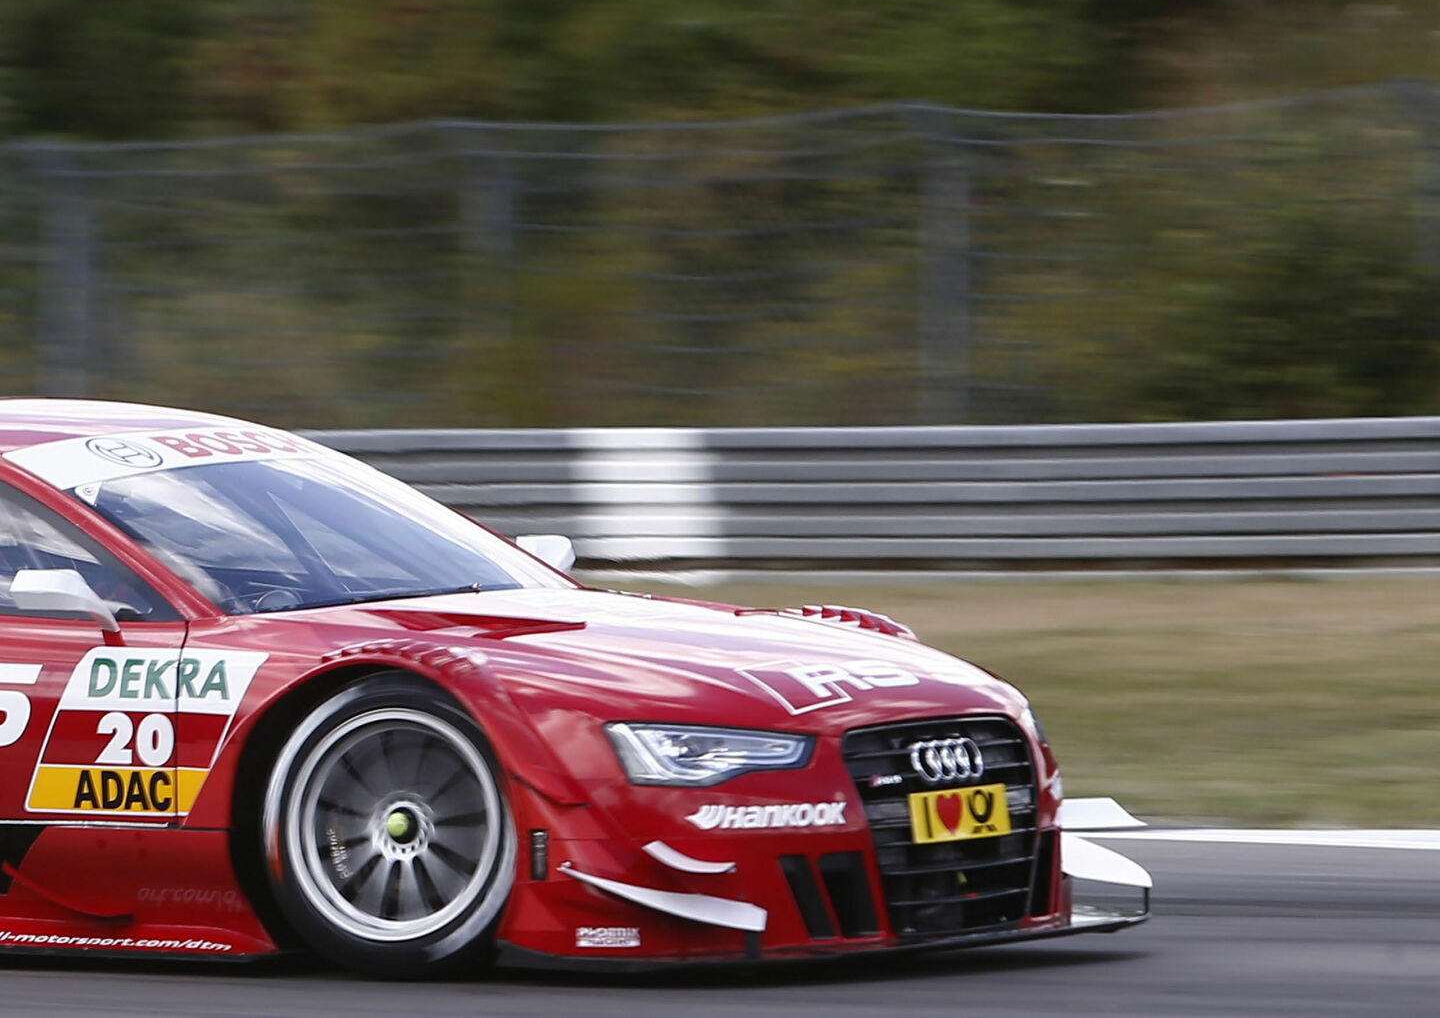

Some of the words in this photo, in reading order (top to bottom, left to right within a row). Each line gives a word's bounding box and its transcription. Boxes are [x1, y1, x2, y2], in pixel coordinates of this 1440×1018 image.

[87, 657, 231, 701] DEKRA
[95, 711, 176, 767] 20
[73, 770, 175, 813] ADAC
